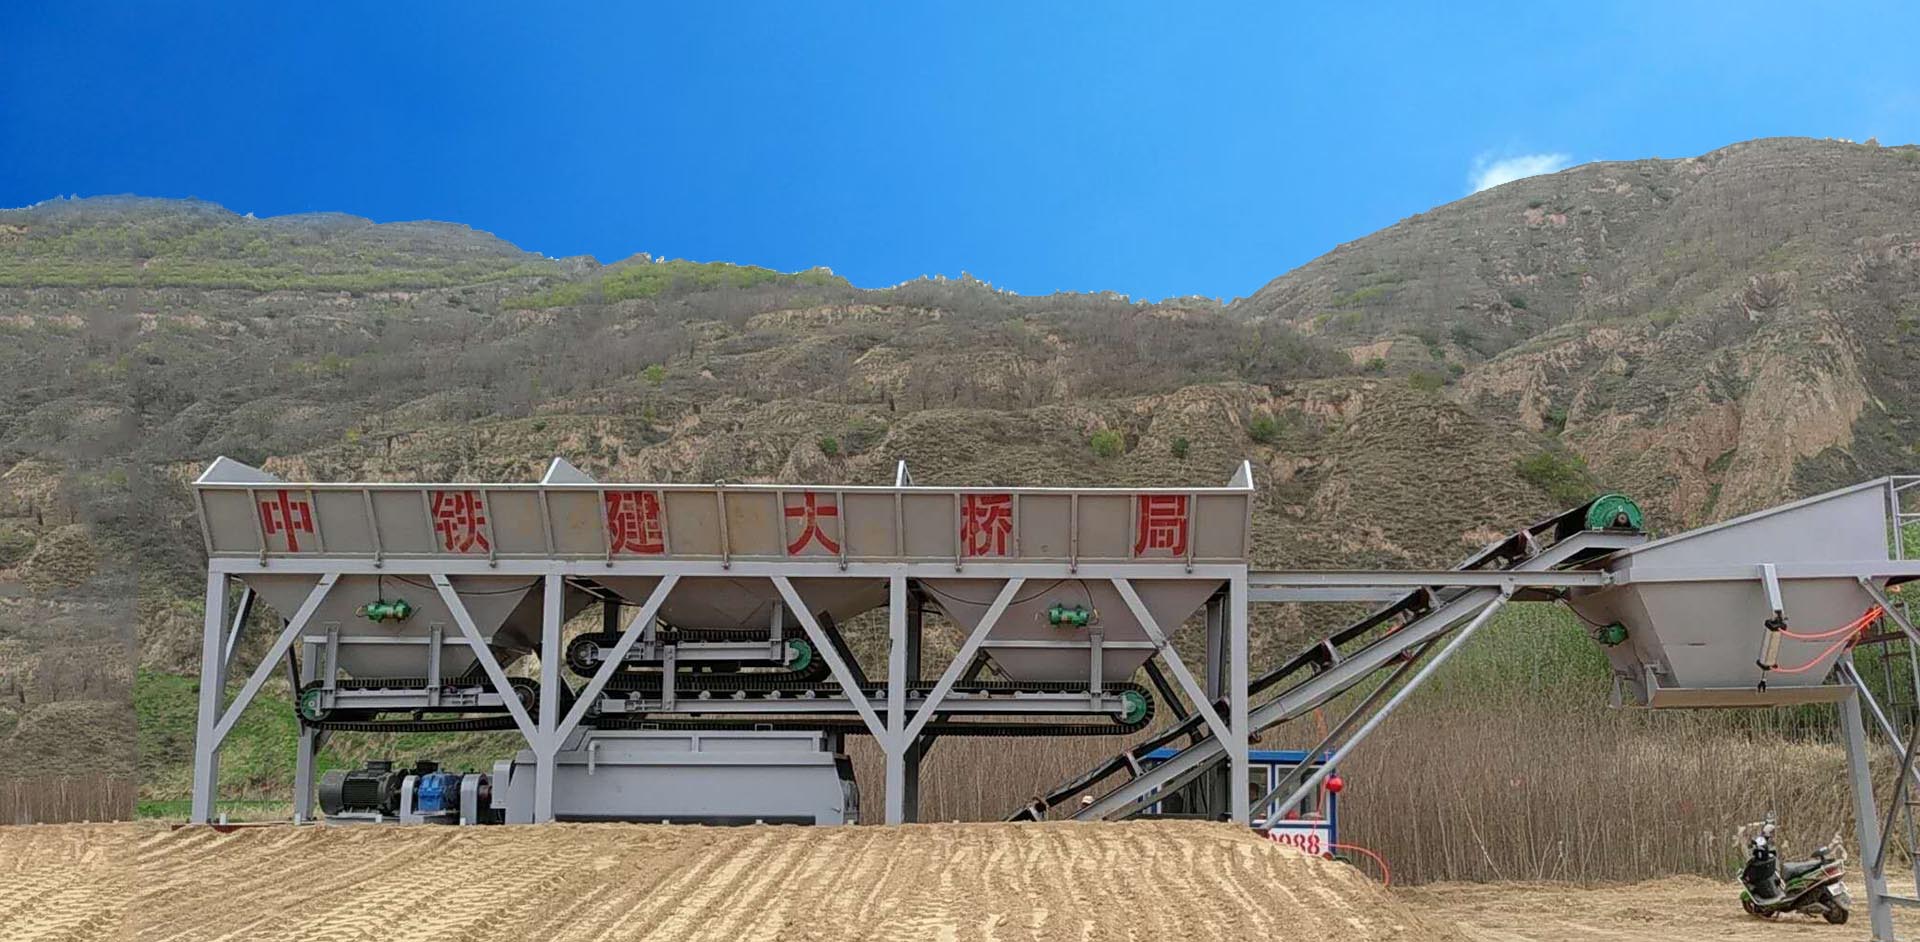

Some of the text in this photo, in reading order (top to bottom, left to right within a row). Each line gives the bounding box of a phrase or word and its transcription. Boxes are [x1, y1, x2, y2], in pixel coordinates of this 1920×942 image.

[261, 489, 1188, 557] 中铁建大桥局
